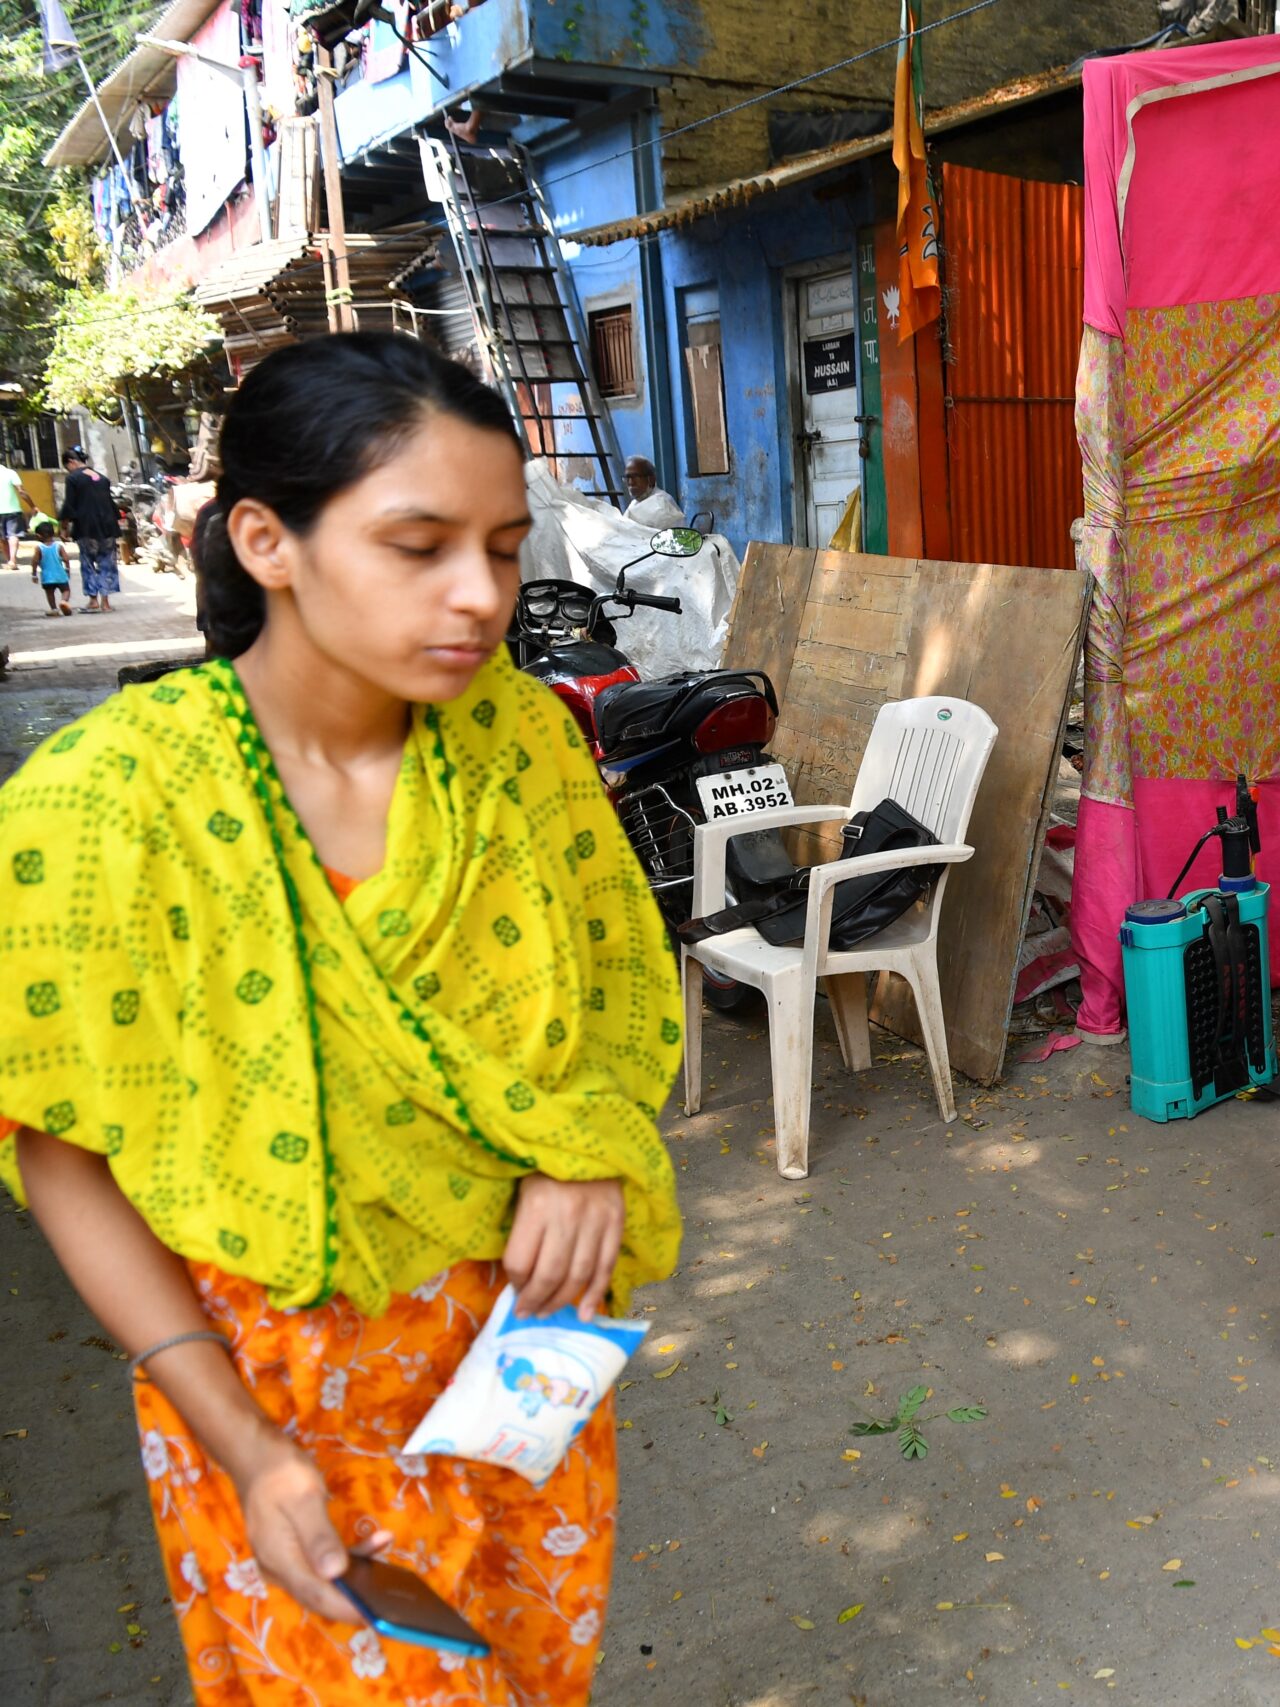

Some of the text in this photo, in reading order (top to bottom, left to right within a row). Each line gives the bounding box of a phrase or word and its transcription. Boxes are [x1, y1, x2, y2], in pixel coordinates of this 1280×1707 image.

[814, 360, 850, 378] HUSSAIN
[711, 777, 775, 800] MH.02
[713, 792, 789, 819] AB.3952
